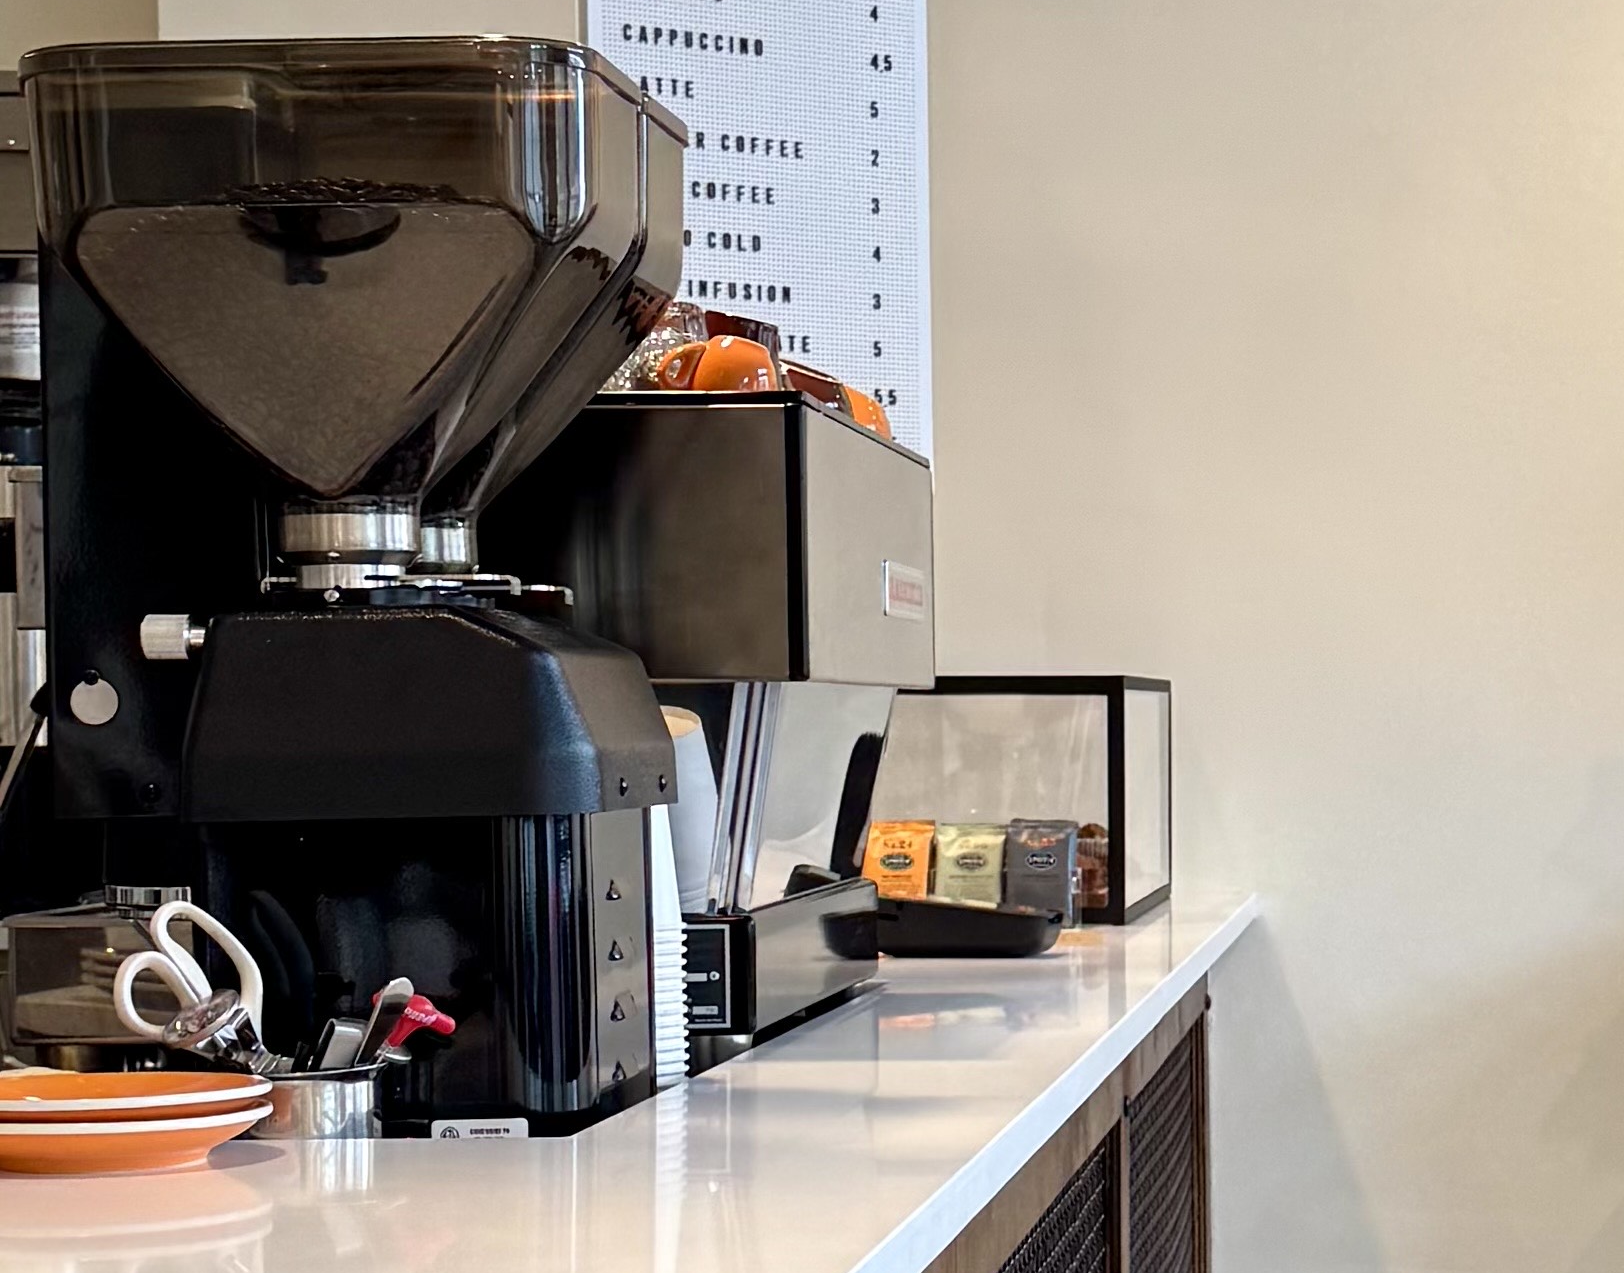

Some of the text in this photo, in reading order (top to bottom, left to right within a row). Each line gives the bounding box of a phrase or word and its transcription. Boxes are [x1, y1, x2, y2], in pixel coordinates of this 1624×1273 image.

[869, 5, 878, 22] 4
[623, 23, 764, 56] CAPPUCCINO
[640, 76, 879, 118] ATTE 5
[721, 134, 804, 159] COFFEE
[871, 150, 880, 167] 2
[691, 181, 880, 215] COFFEE 3
[707, 231, 762, 253] COLD
[872, 246, 881, 263] 4
[688, 279, 881, 310] INFUSION 3
[873, 341, 882, 358] 5
